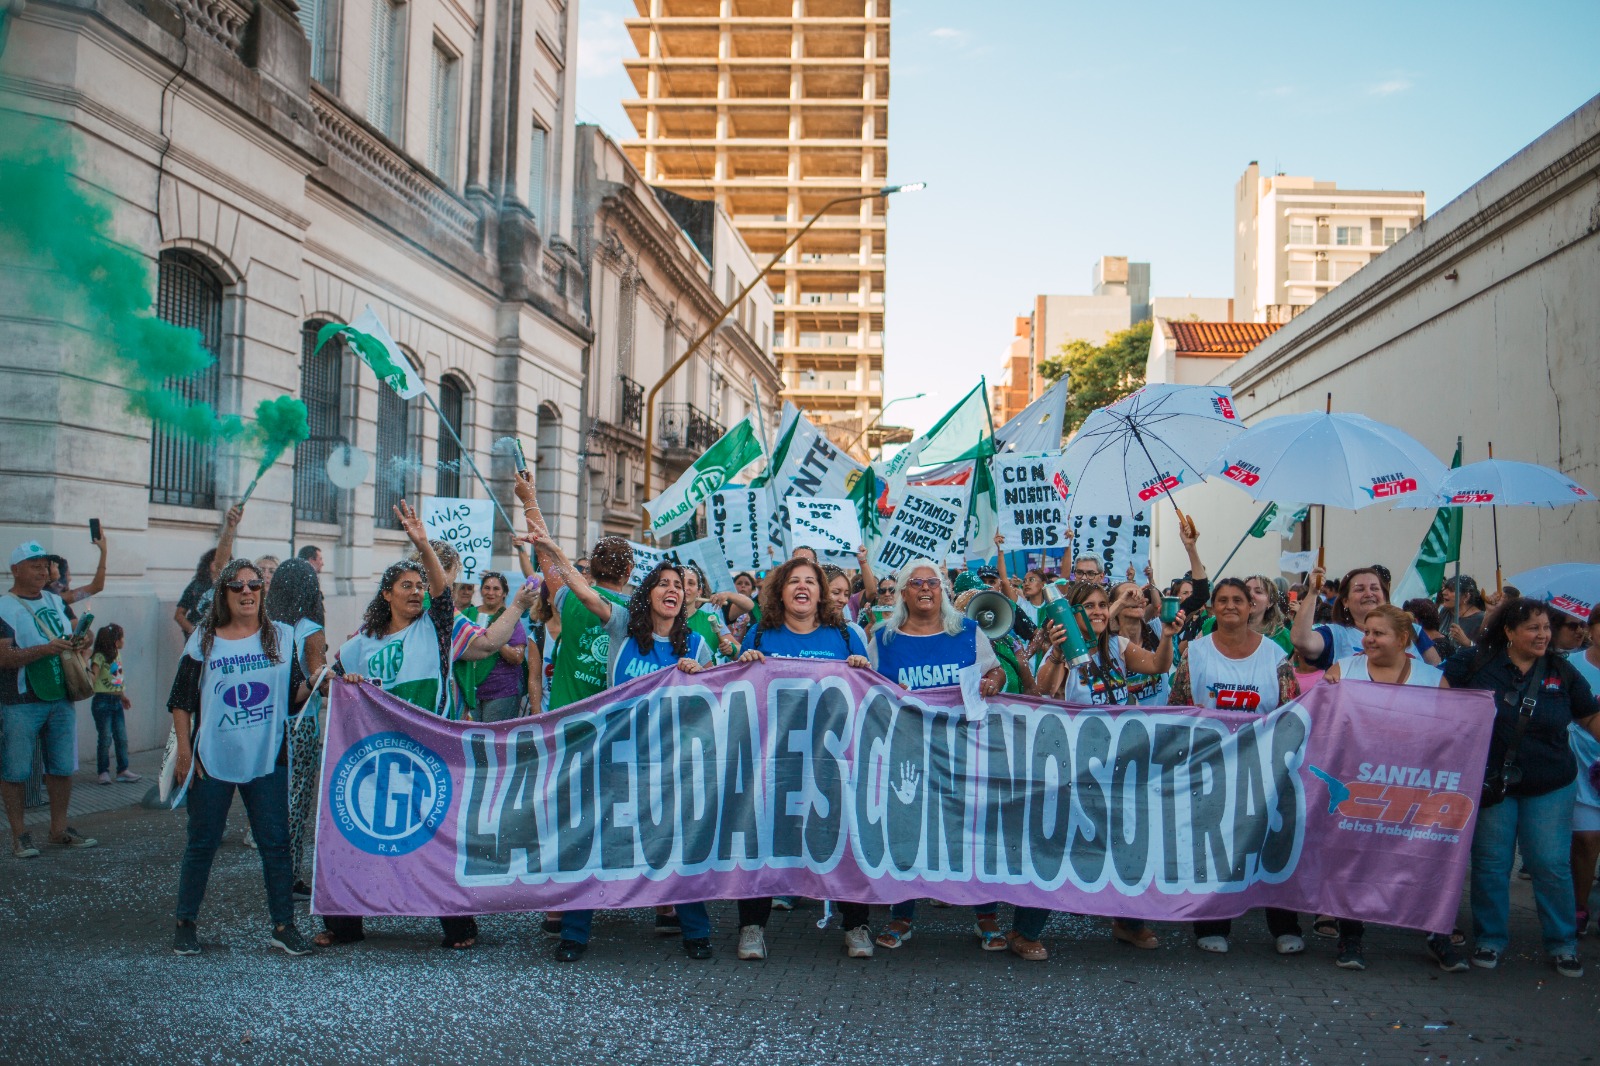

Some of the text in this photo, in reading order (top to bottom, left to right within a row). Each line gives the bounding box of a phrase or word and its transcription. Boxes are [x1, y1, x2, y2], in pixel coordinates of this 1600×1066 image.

[1003, 463, 1045, 483] CON
[1224, 465, 1260, 487] CTA
[1371, 472, 1405, 484] SANTA FE
[1004, 485, 1061, 505] NOSOTR
[1372, 478, 1417, 498] CTA
[797, 502, 841, 511] BASTA
[1451, 494, 1494, 503] CTA
[904, 494, 957, 525] ESTAMOS
[1014, 508, 1061, 525] NUNCA
[440, 523, 471, 542] NOS
[896, 509, 953, 541] DISPUESTAS
[890, 525, 900, 537] A
[901, 529, 938, 552] HACER
[1021, 525, 1058, 546] MAS
[210, 653, 268, 671] trabajadora
[222, 661, 235, 674] de
[624, 658, 668, 679] AMS
[574, 671, 600, 687] SANTA
[898, 663, 960, 689] AMSAFE
[335, 738, 447, 831] CONFEDERACION GENERAL DEL TRABAJO
[460, 681, 1309, 890] LA DEUDA ES CON NOSOTRAS
[1357, 762, 1461, 791] SANTA FE
[1338, 781, 1474, 831] CTA
[1338, 819, 1459, 843] de lxs Trabajadorxs
[378, 844, 400, 853] R. A.
